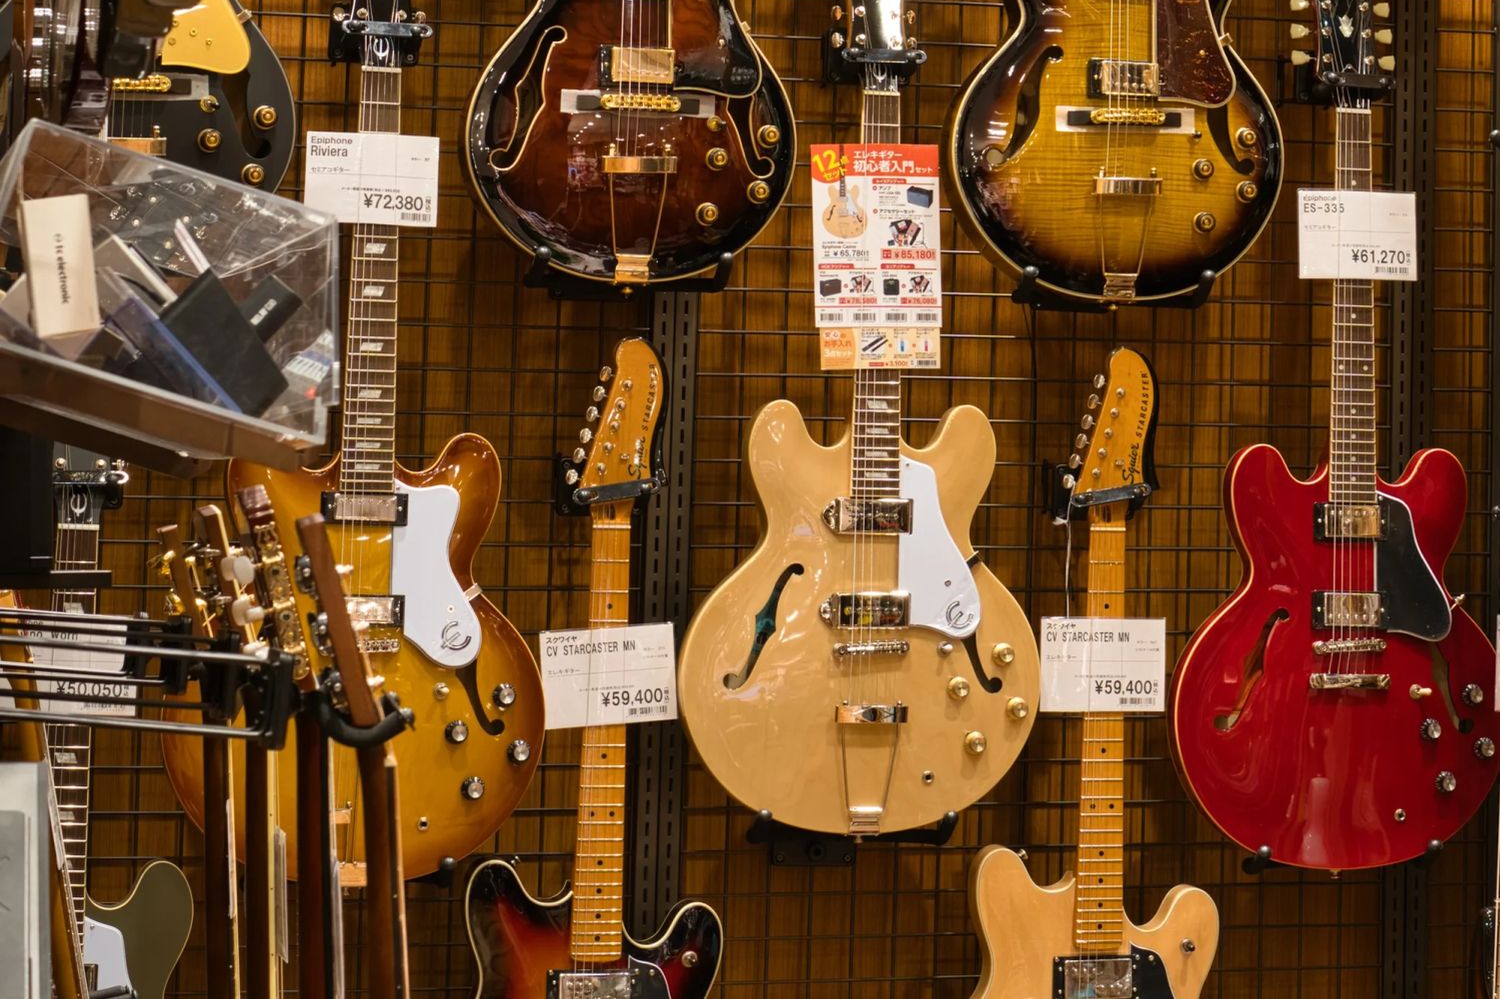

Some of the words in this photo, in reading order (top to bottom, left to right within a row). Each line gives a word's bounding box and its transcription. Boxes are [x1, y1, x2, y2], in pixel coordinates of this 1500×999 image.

[311, 136, 353, 145] Epiphone
[310, 145, 348, 157] Riviera
[853, 150, 902, 159] エレキギター
[364, 193, 423, 211] ¥72,380
[1303, 203, 1345, 213] ES-335
[1351, 249, 1405, 264] ¥61,270
[55, 253, 70, 304] electronic
[1136, 372, 1149, 437] STARCASTER
[1122, 442, 1140, 485] Squier
[546, 636, 578, 644] スクワイヤ
[1046, 632, 1057, 642] CV
[1062, 631, 1114, 642] STARCASTER
[1118, 632, 1130, 642] MN
[546, 645, 558, 657] CV
[563, 641, 618, 656] STARCASTER
[623, 640, 636, 651] MN
[1095, 680, 1152, 695] ¥59,400
[602, 688, 663, 707] ¥59,400
